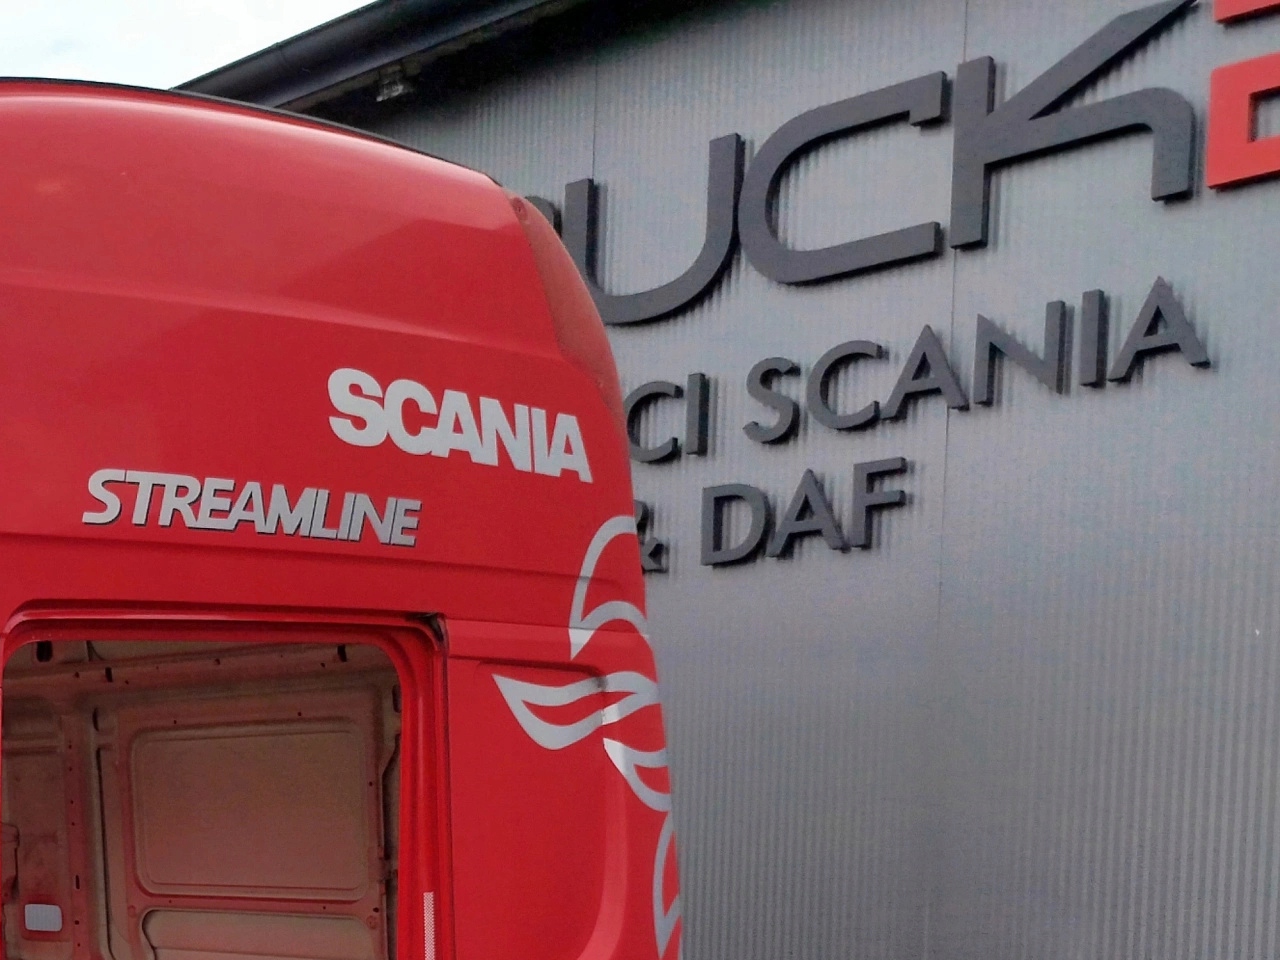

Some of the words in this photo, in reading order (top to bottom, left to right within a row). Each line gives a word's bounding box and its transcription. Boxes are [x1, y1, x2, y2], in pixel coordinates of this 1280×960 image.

[524, 0, 1280, 326] UCK
[743, 276, 1210, 444] SCANIA
[327, 367, 593, 484] SCANIA
[81, 467, 422, 548] STREAMLINE
[701, 456, 911, 566] DAF
